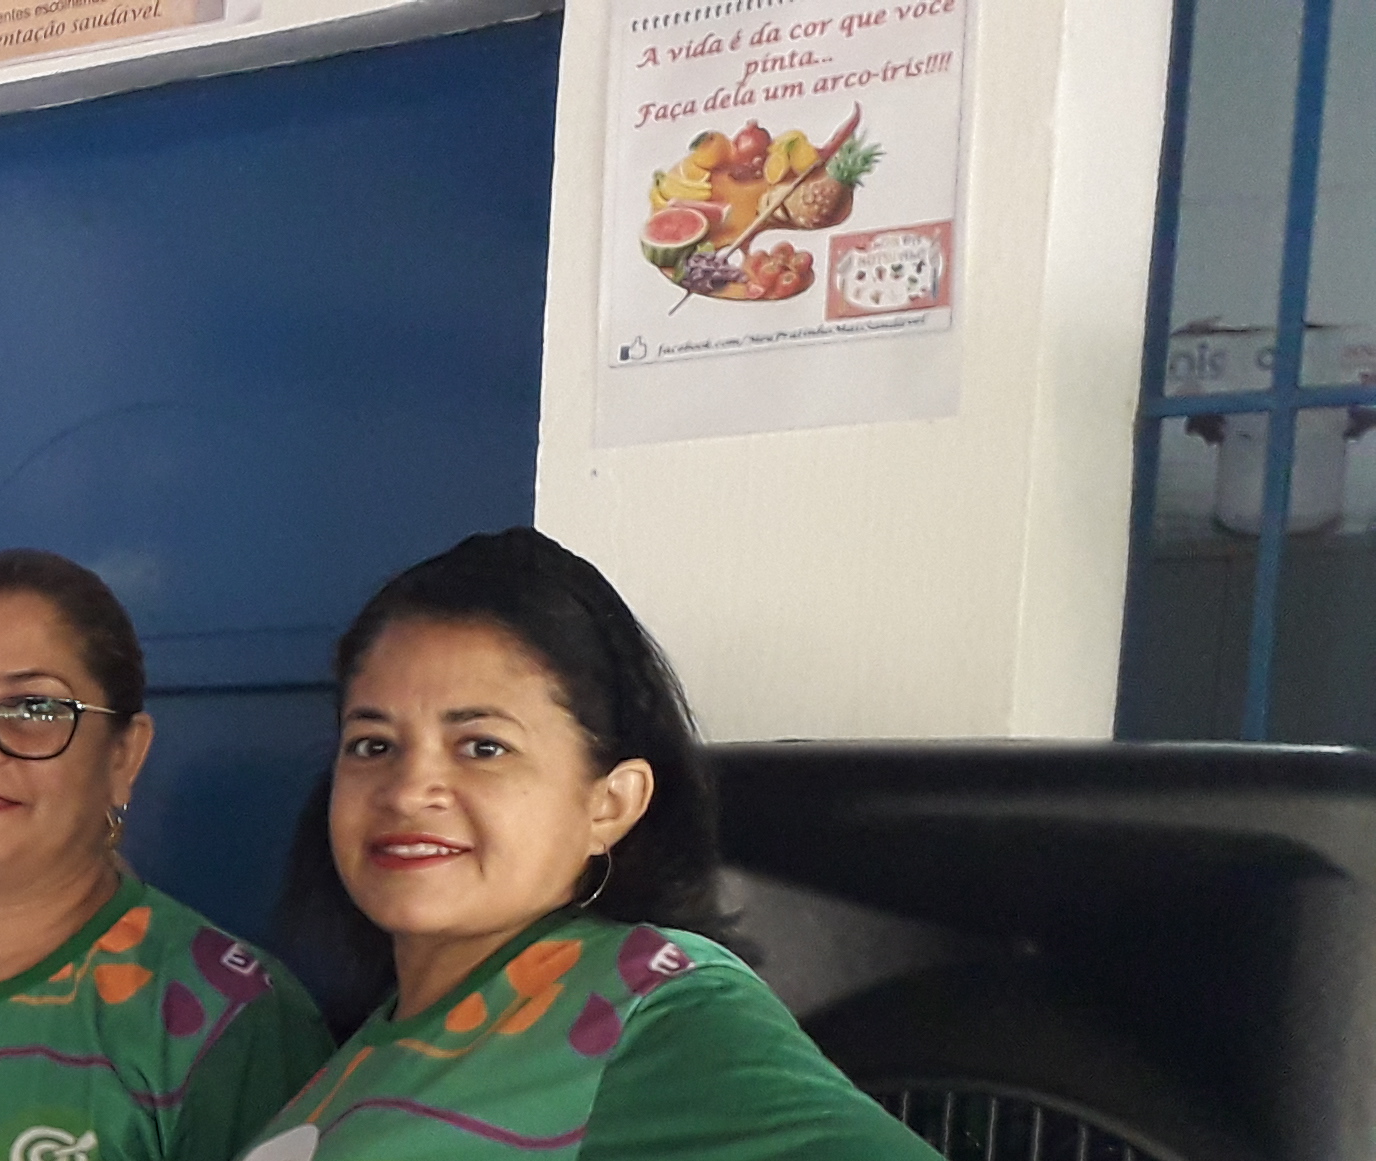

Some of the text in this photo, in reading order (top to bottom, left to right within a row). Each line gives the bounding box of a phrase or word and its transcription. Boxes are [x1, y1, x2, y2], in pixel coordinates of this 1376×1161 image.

[637, 47, 658, 68] A
[667, 32, 722, 62] vida
[729, 29, 741, 51] é
[750, 22, 780, 47] da
[789, 19, 832, 39] cor
[840, 9, 886, 37] que
[736, 50, 833, 84] pinta...
[635, 102, 697, 128] Faça
[703, 83, 754, 112] dela
[763, 82, 805, 99] um
